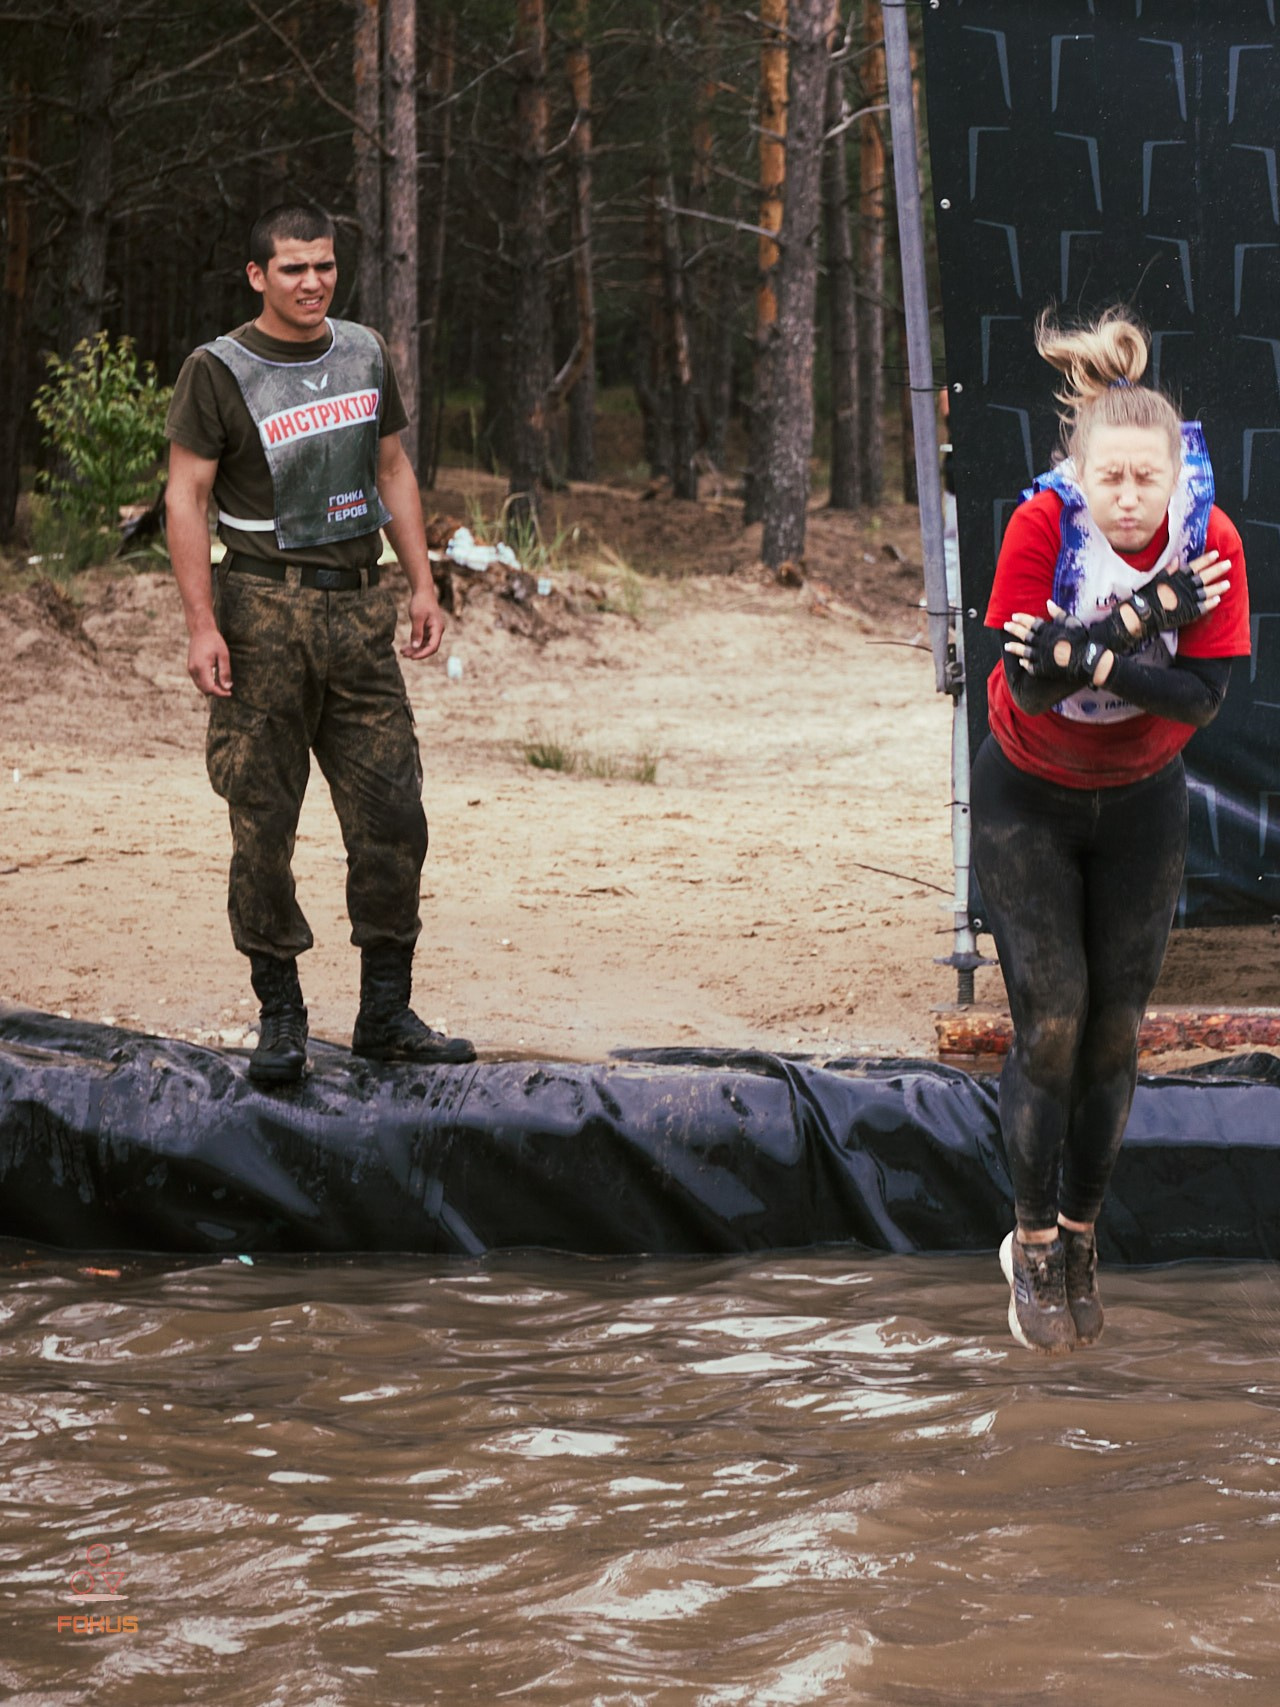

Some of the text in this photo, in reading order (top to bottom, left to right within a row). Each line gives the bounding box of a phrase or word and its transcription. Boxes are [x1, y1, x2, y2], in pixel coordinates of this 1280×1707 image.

[264, 393, 378, 445] ИНСТРУКТОР
[328, 489, 364, 507] ГОНКА
[327, 503, 368, 523] ГЕРОЕВ
